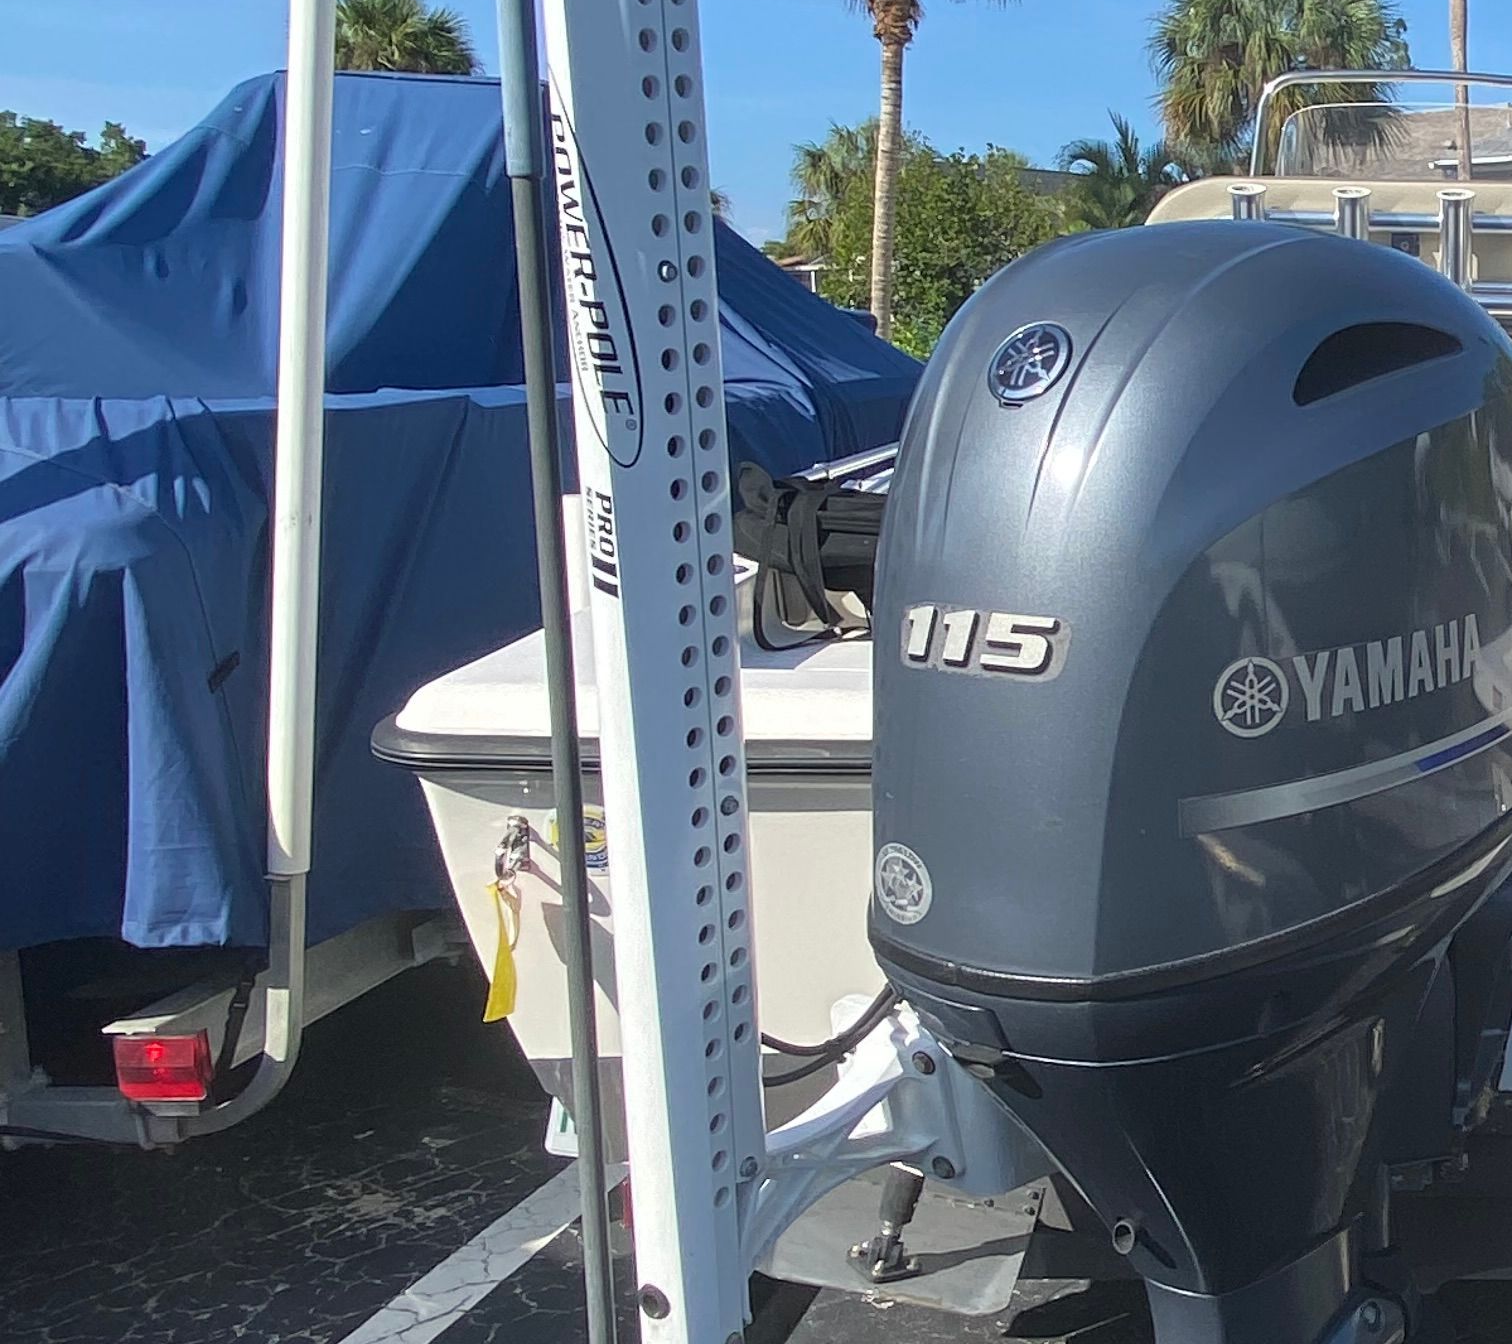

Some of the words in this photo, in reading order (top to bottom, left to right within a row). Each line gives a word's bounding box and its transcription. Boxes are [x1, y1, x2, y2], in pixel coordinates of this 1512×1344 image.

[552, 114, 634, 415] POWER-POLE
[595, 491, 615, 557] PRO
[904, 605, 1061, 676] 115
[1292, 613, 1482, 722] YAMAHA
